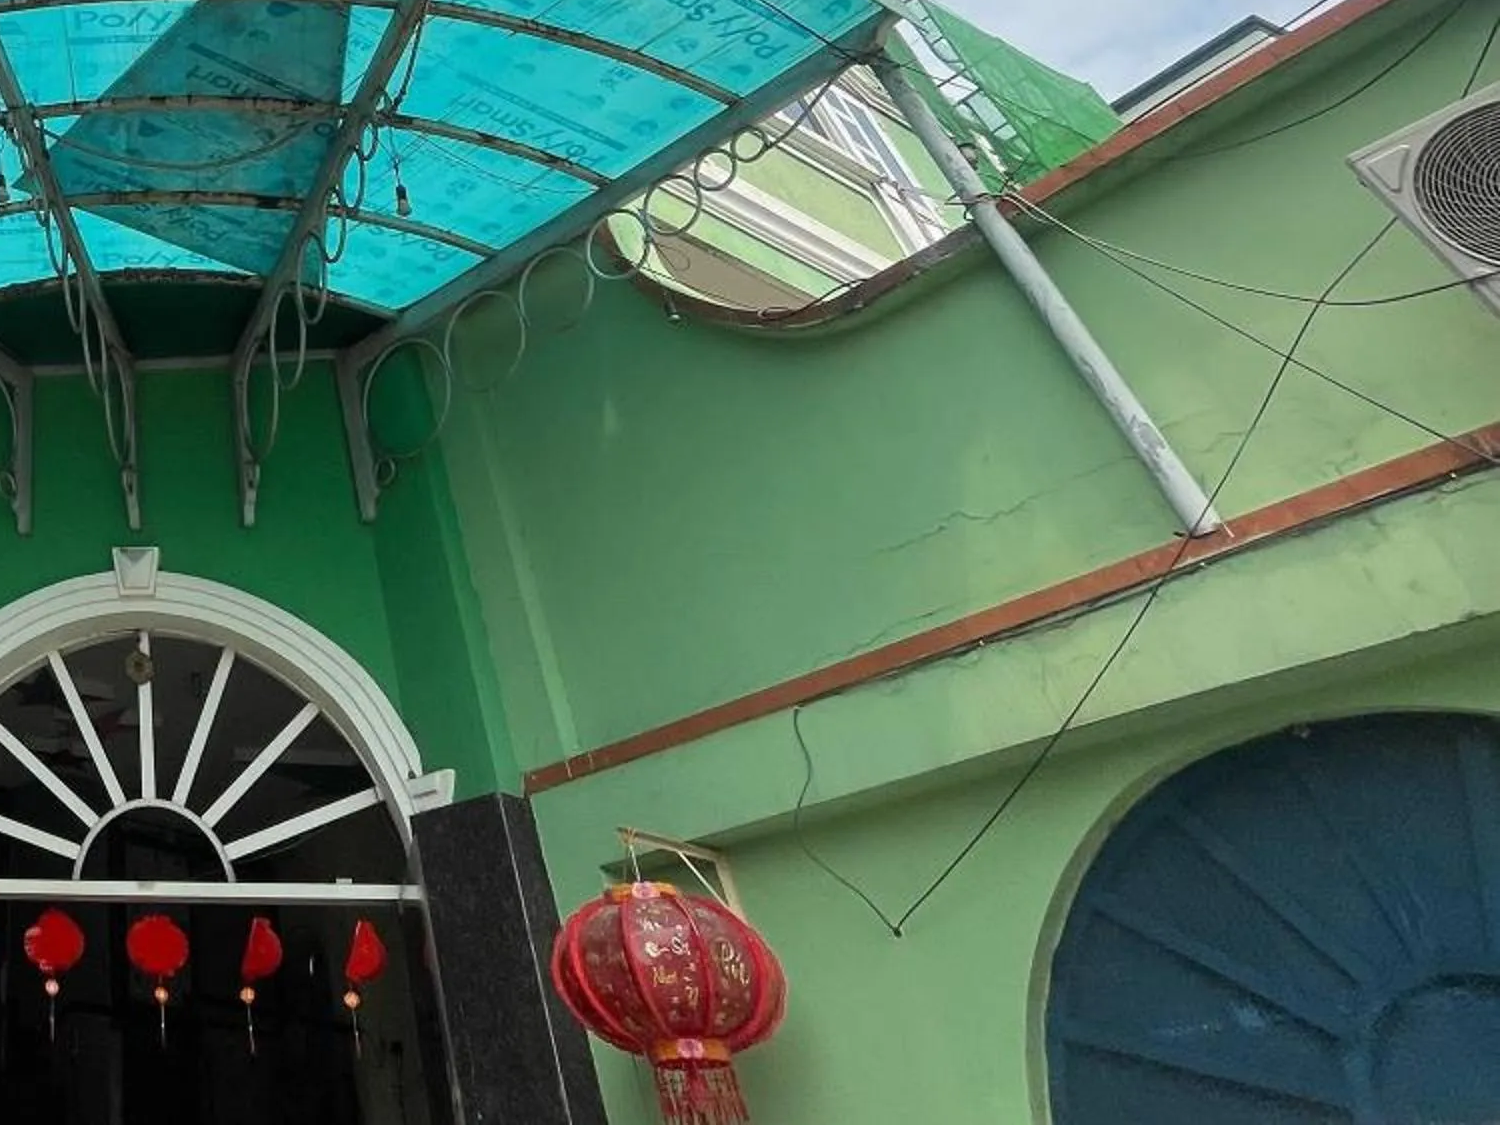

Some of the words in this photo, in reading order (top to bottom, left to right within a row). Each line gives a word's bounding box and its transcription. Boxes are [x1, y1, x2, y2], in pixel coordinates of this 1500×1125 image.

[74, 7, 174, 31] Poly
[708, 13, 790, 59] Poly
[450, 93, 535, 138] Smart
[531, 129, 607, 167] Poly
